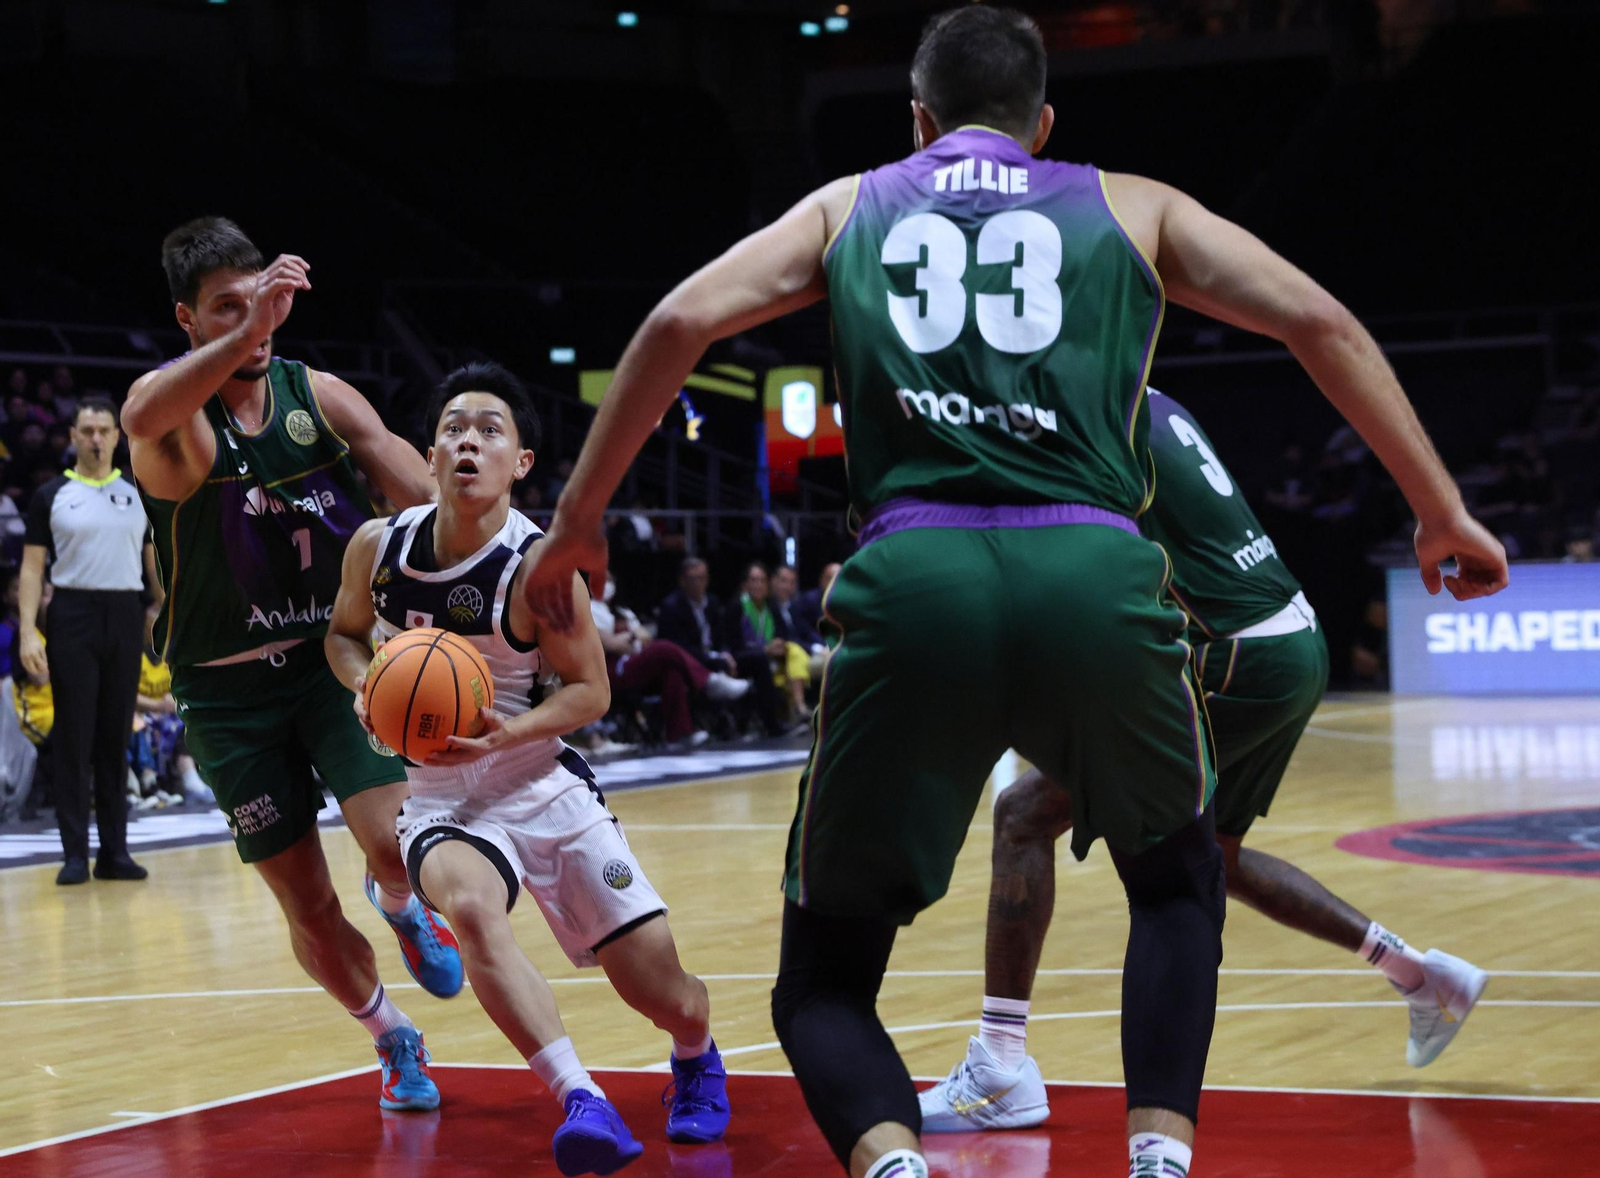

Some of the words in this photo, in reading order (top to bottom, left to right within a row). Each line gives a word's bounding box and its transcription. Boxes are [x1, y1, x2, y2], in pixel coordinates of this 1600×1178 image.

[933, 157, 1028, 194] TILLIE
[881, 209, 1062, 354] 33
[1168, 414, 1234, 497] 3
[291, 528, 312, 571] 1
[246, 594, 334, 632] Andaluc
[1425, 609, 1600, 654] SHAPED
[417, 713, 434, 739] FIBA
[233, 793, 272, 818] COSTA
[238, 814, 258, 828] DEL
[257, 803, 277, 819] SOL
